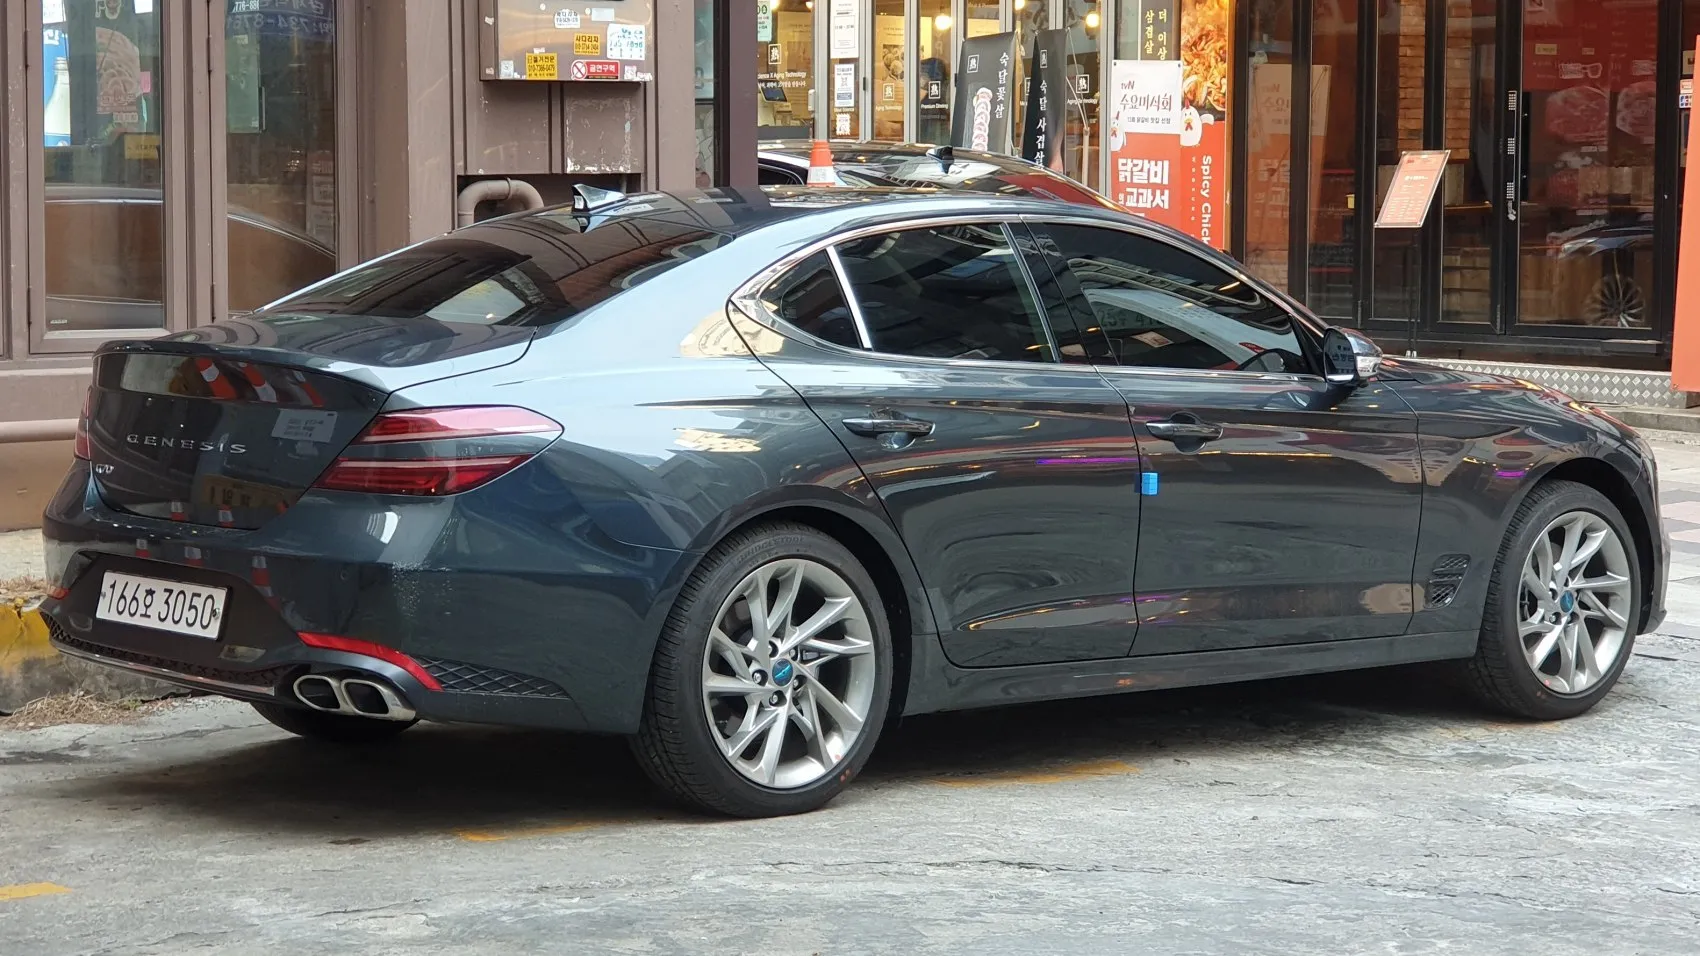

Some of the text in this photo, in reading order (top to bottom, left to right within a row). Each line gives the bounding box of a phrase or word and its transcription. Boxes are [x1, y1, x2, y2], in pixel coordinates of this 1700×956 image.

[575, 35, 599, 43] 사다리차
[1144, 9, 1155, 54] 삼겹살
[1157, 8, 1168, 60] 더 이상
[589, 64, 615, 73] 금연구역
[1121, 80, 1135, 90] tvN
[1119, 93, 1173, 112] 수요미식회
[1117, 157, 1170, 185] 닭갈비
[1201, 155, 1212, 198] Spicy
[1125, 187, 1170, 210] 교과서
[126, 433, 247, 454] GENESIS
[108, 579, 216, 630] 166호 3050
